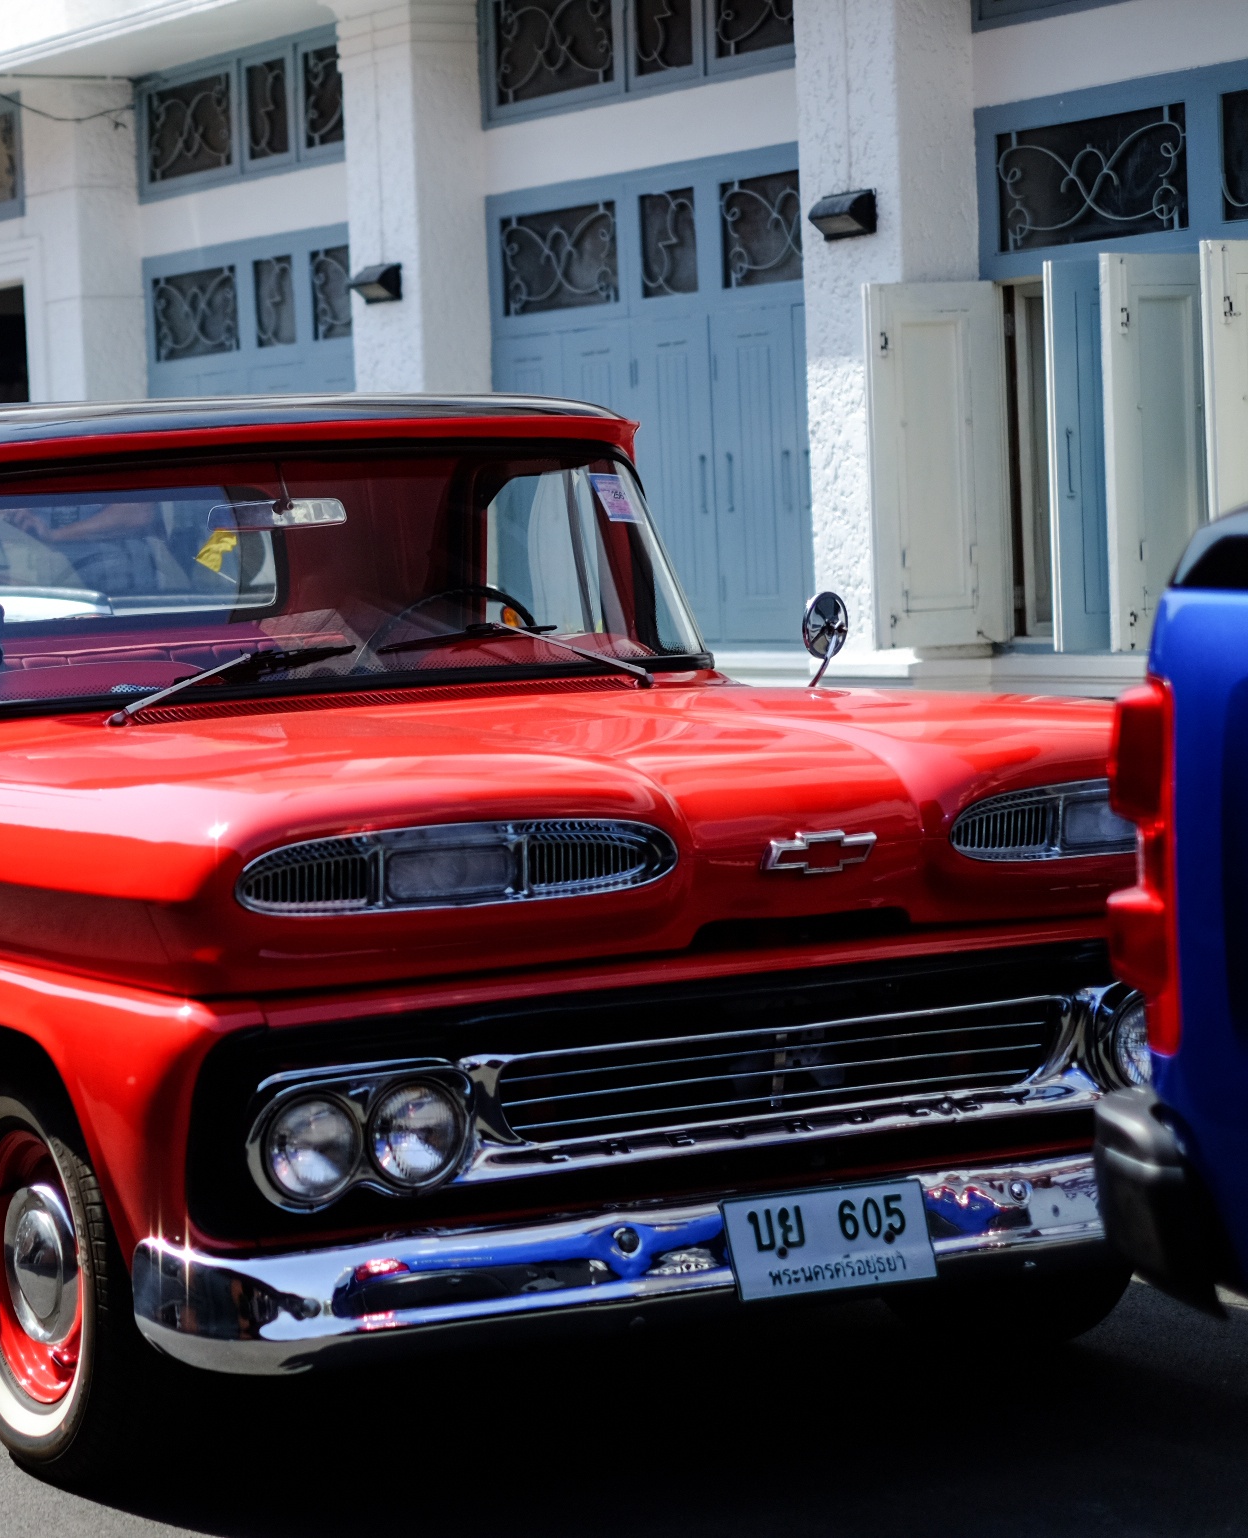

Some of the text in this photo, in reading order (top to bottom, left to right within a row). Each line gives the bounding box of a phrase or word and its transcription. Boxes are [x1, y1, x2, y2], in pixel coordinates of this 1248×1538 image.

[747, 1194, 906, 1252] บย 605
[768, 1254, 907, 1287] พระนครศรีอยุธยา
